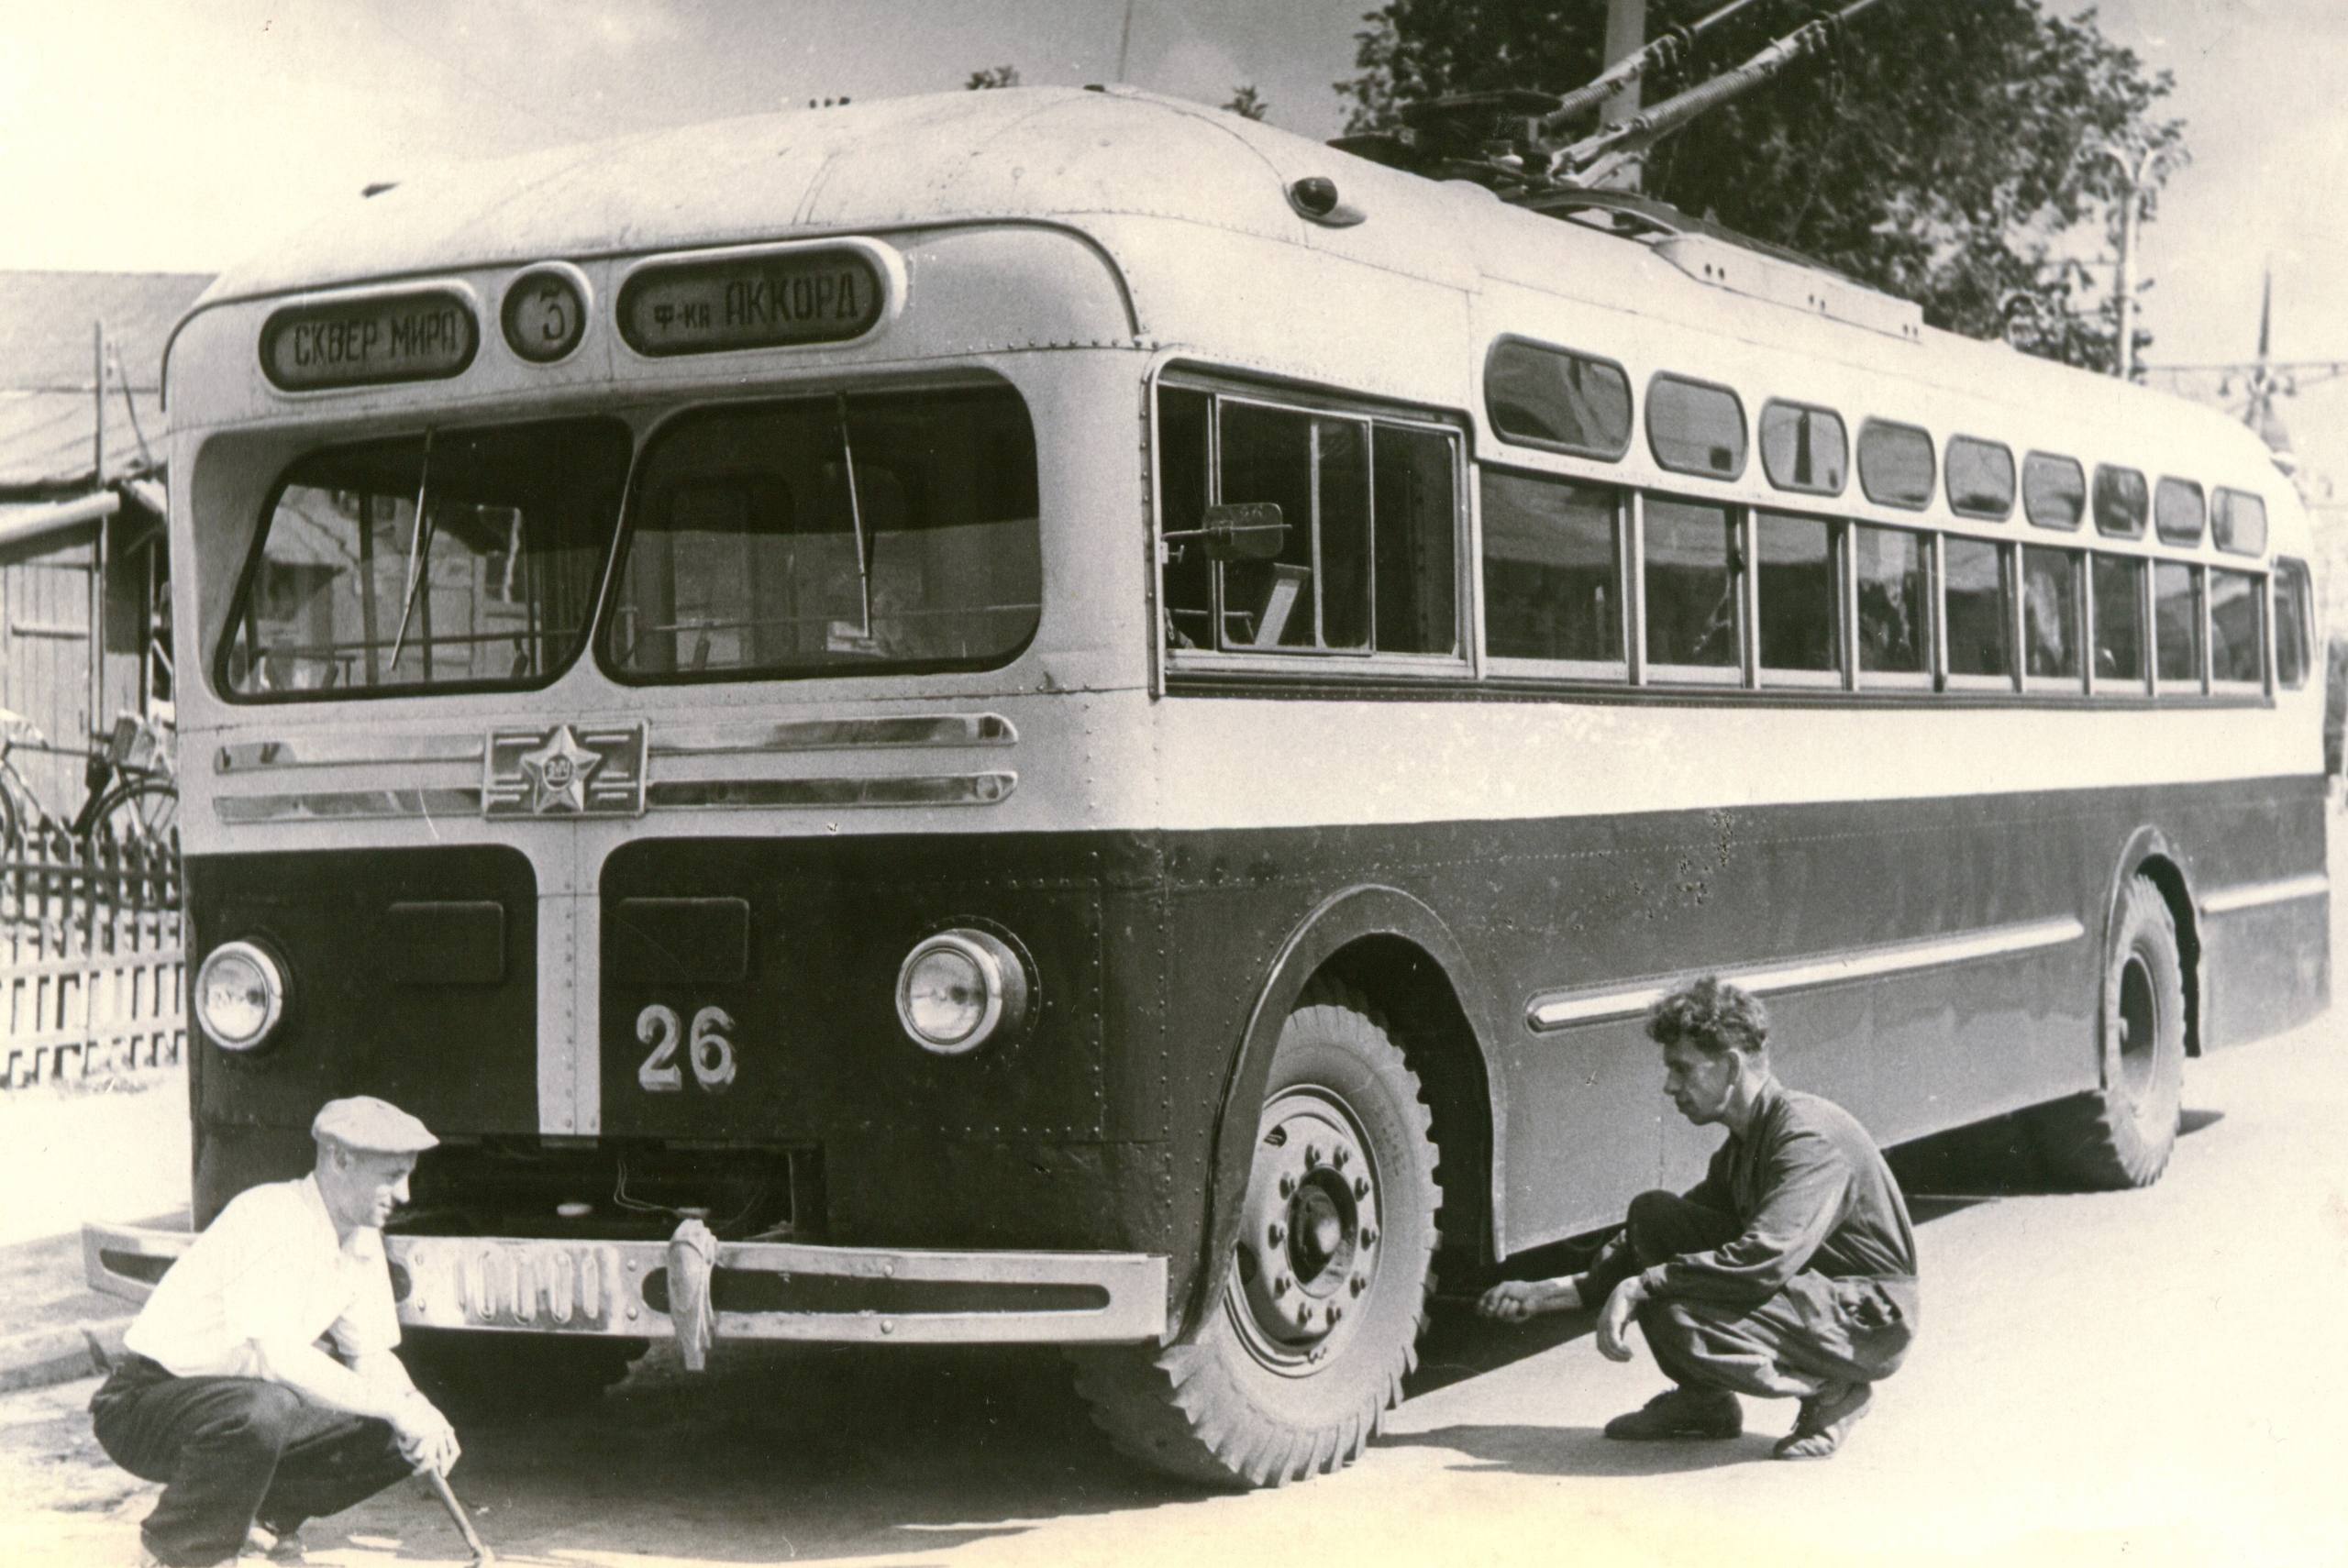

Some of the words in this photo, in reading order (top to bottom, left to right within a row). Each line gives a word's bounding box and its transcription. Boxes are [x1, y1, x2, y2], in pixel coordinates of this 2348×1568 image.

[540, 287, 566, 340] 3
[725, 272, 858, 326] АККОРД
[294, 317, 377, 367] СКВЕР
[390, 308, 457, 359] МИРА
[637, 1004, 737, 1092] 26
